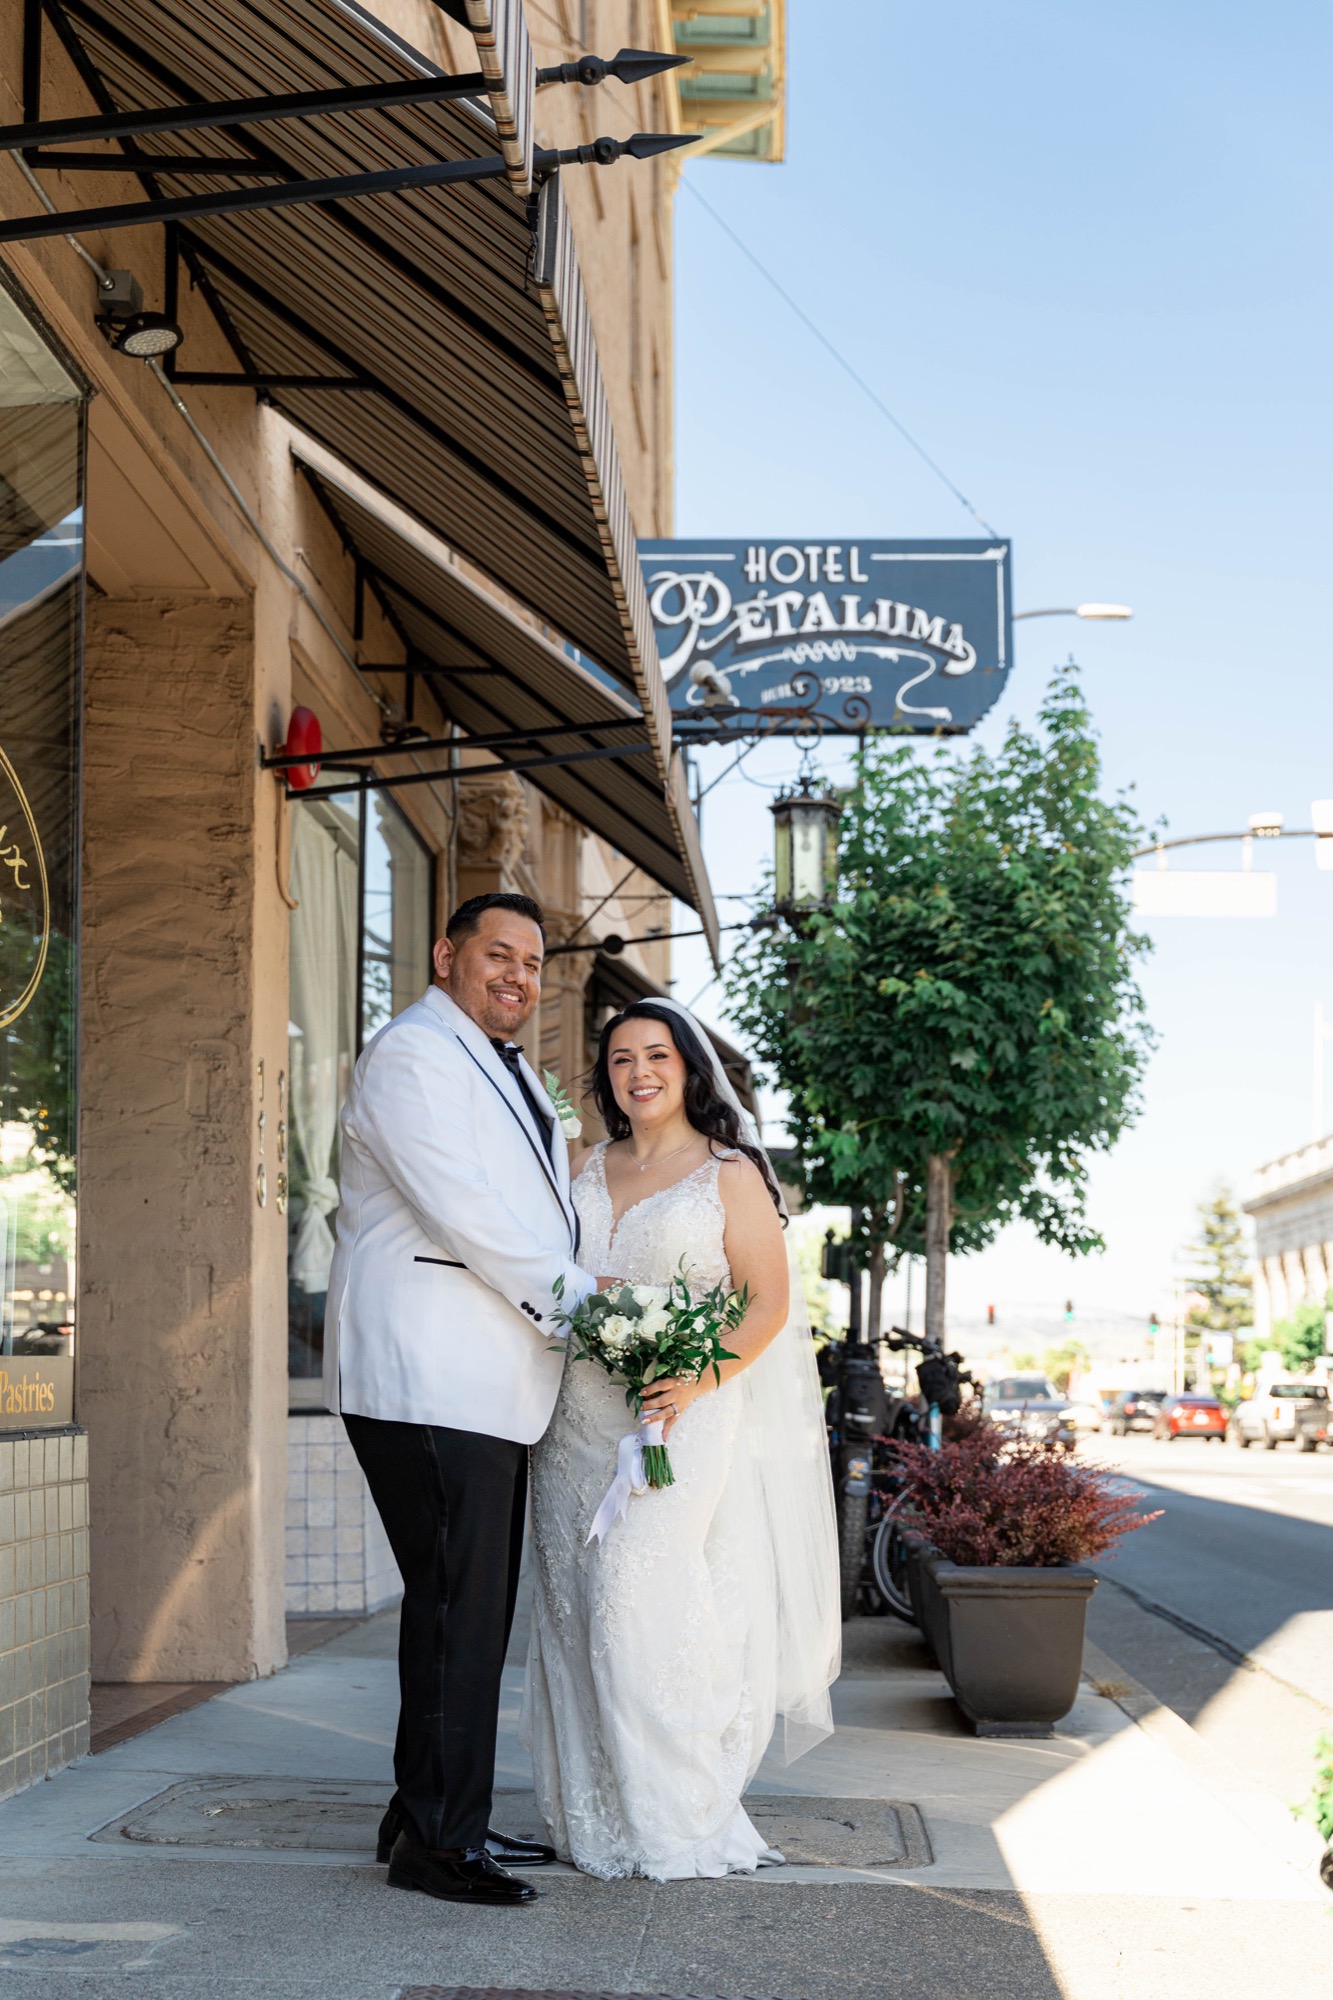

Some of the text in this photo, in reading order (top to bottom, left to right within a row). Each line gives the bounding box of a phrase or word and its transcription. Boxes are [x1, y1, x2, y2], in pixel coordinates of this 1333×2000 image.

[743, 546, 869, 583] HOTEL
[648, 570, 977, 683] PETALUMA
[822, 675, 873, 695] 923
[0, 1370, 55, 1414] Pastries
